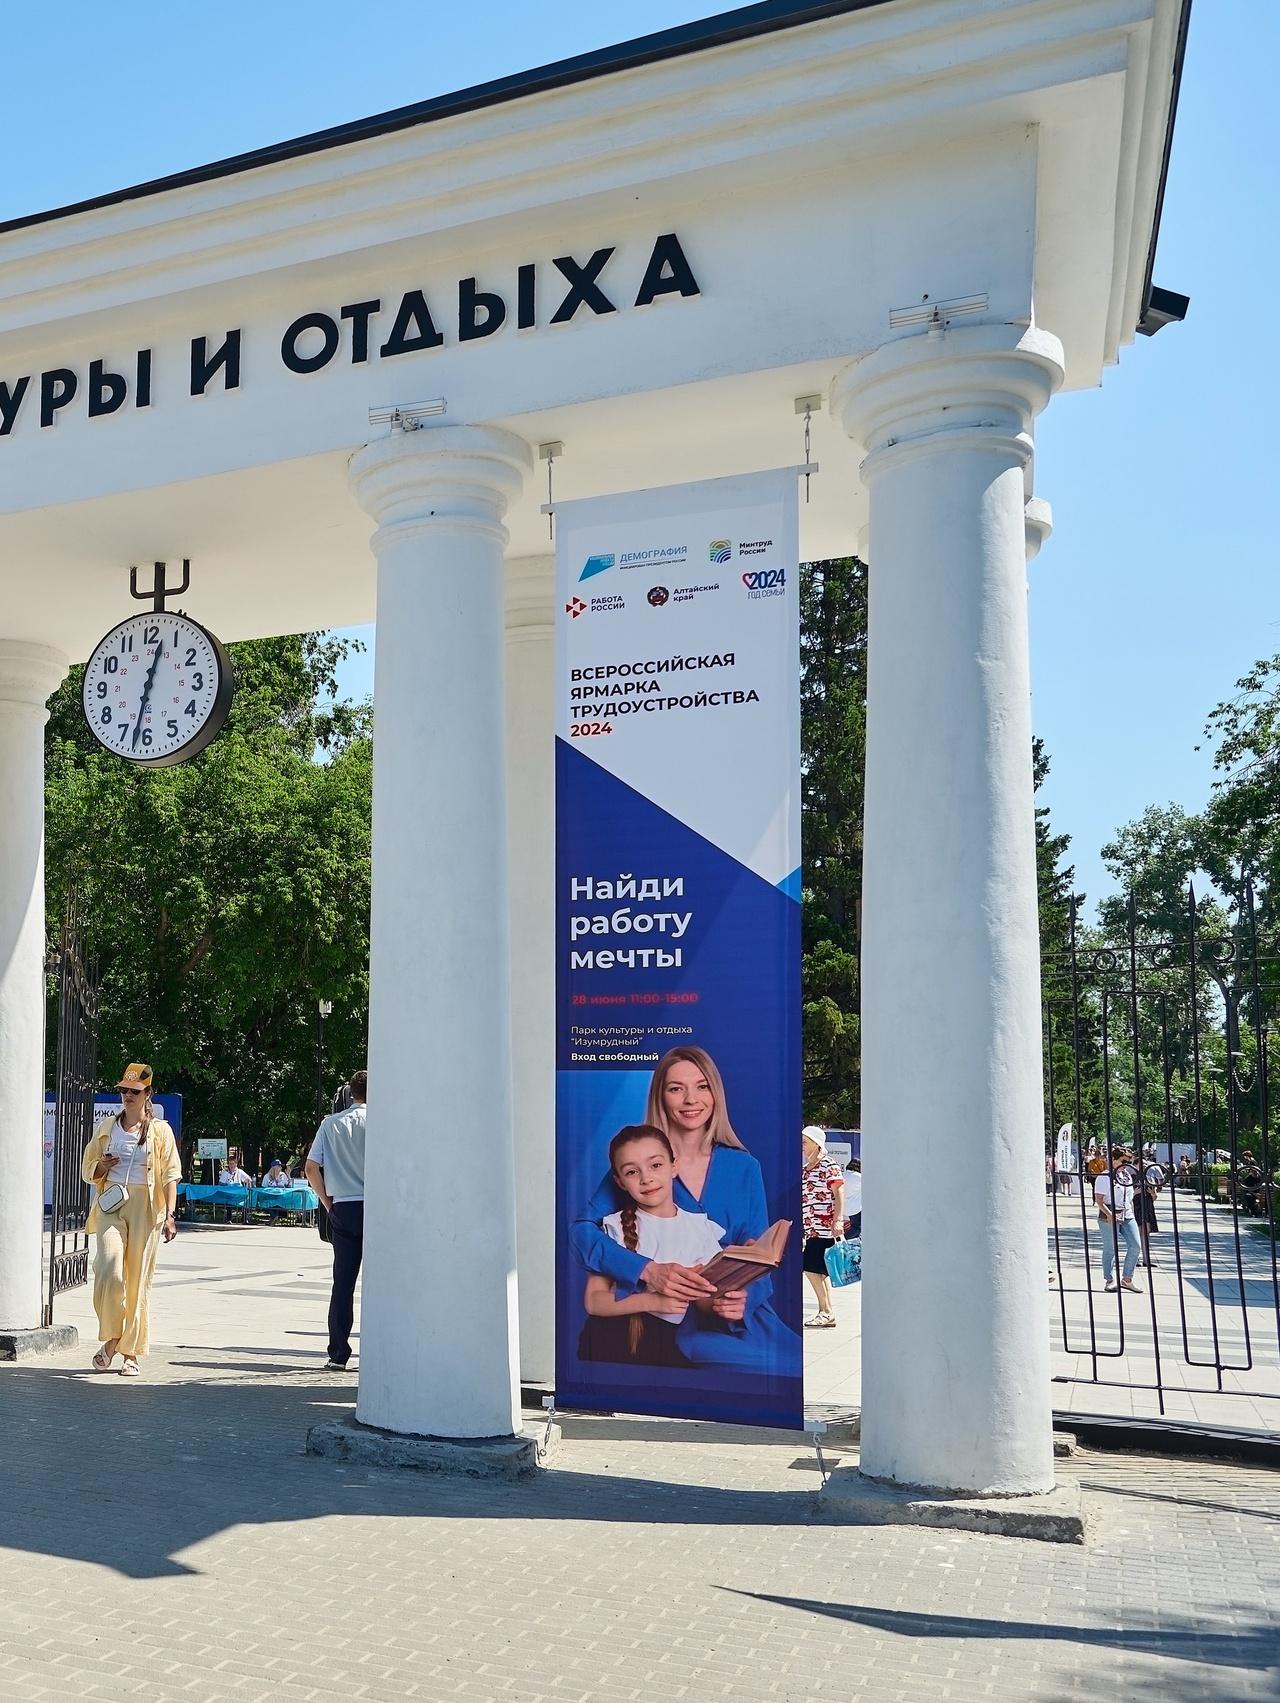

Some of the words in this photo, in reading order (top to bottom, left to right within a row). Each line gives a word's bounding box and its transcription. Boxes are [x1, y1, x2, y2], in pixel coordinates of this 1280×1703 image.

[190, 328, 242, 397] И
[281, 232, 702, 374] ОТДЫХА
[739, 540, 773, 549] Минтруд
[739, 547, 766, 555] России
[620, 546, 687, 563] ДЕМОГРАФИЯ
[673, 583, 719, 595] Алтайский
[749, 569, 786, 590] 2024
[591, 595, 623, 605] РАБОТА
[591, 603, 625, 612] РОССИИ
[673, 594, 694, 603] край
[121, 634, 133, 653] 11
[144, 626, 160, 645] 12
[173, 629, 179, 648] 1
[103, 655, 119, 674] 10
[185, 648, 197, 667] 2
[571, 653, 735, 682] ВСЕРОССИЙСКАЯ
[97, 681, 108, 699] 9
[191, 672, 203, 691] 3
[570, 680, 661, 701] ЯРМАРКА
[184, 699, 196, 718] 4
[570, 690, 760, 719] ТРУДОУСТРОЙСТВА
[100, 706, 112, 725] 8
[118, 723, 130, 742] 7
[141, 728, 153, 746] 6
[166, 719, 179, 738] 5
[571, 722, 612, 737] 2024
[571, 873, 684, 901] Найди
[571, 908, 693, 941] работу
[571, 948, 682, 970] мечты
[572, 995, 586, 1004] 28
[590, 996, 626, 1004] июня
[630, 993, 698, 1003] 11:00-15:00
[571, 1026, 596, 1035] Парк
[599, 1027, 645, 1036] культуры
[656, 1026, 693, 1034] отдыха
[571, 1052, 596, 1061] Вход
[599, 1052, 659, 1061] свободный
